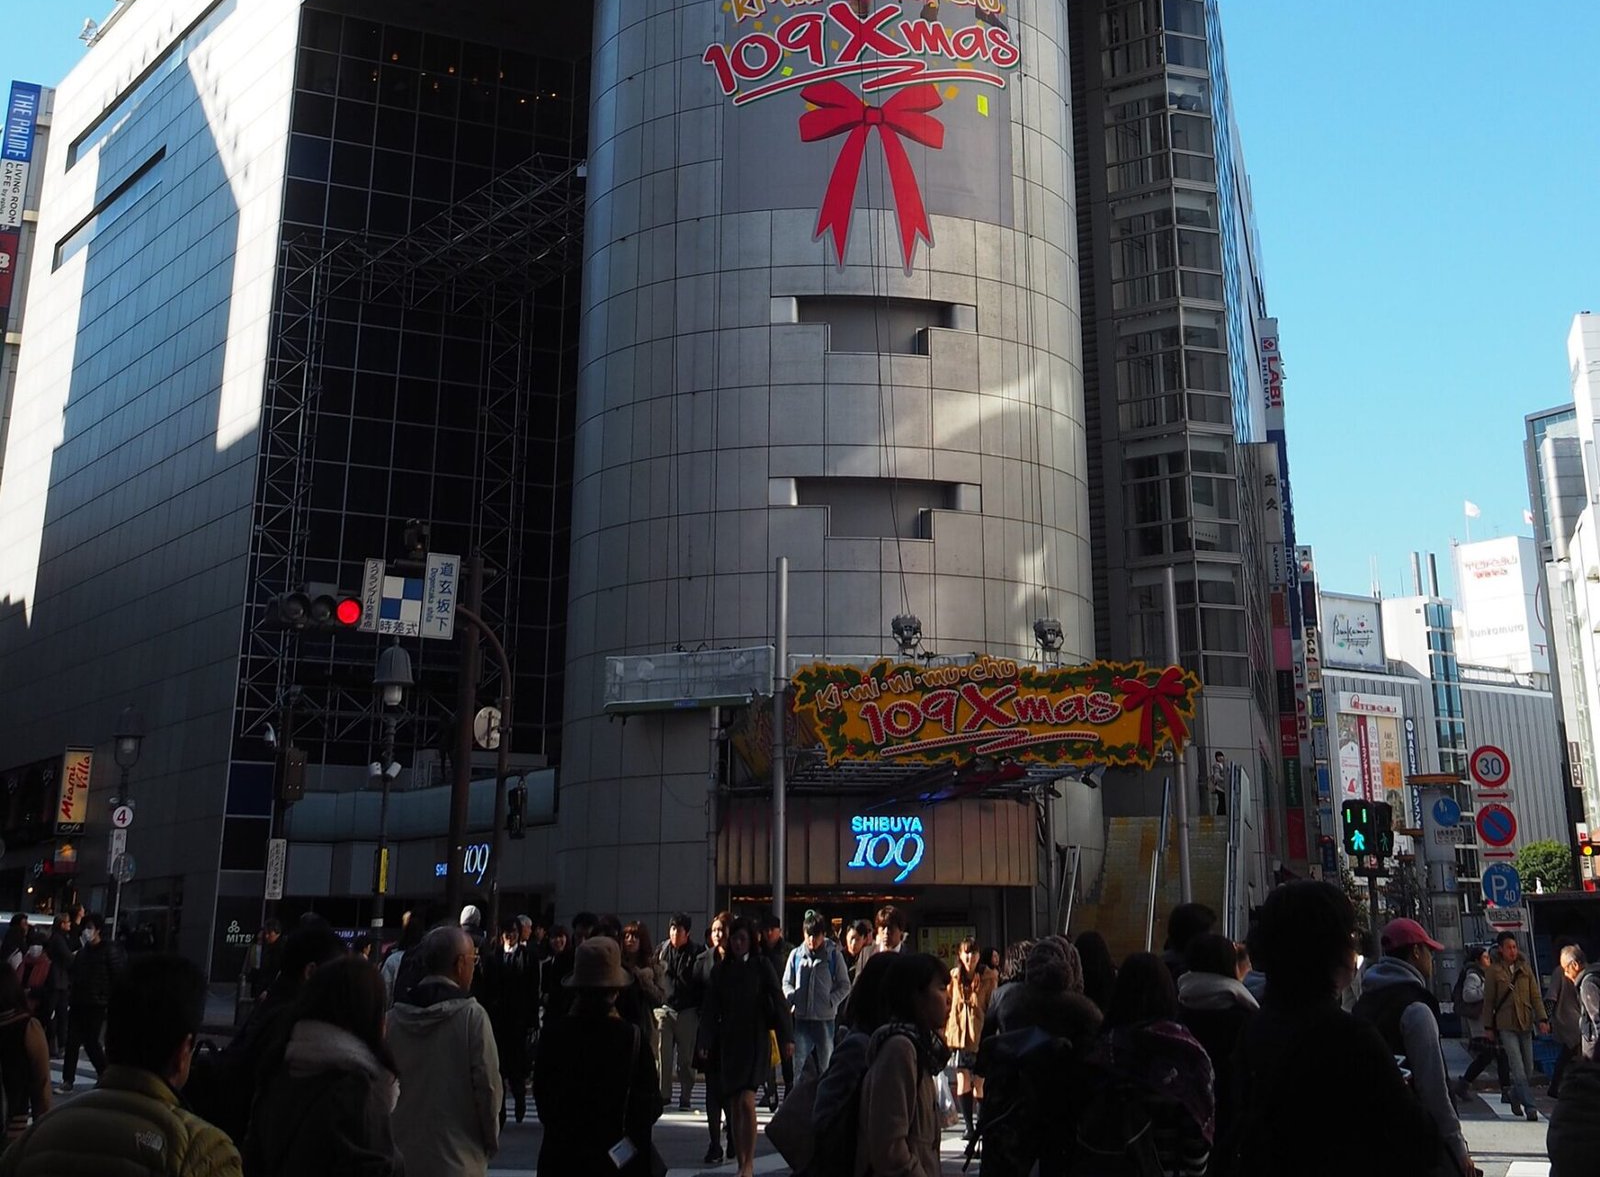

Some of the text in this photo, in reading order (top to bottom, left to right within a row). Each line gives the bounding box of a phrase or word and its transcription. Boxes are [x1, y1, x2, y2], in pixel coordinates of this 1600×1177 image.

[6, 118, 31, 158] PRIME
[3, 161, 14, 188] CAFE
[7, 163, 24, 225] LIVING ROOM
[1261, 356, 1271, 410] SHIBUYA
[1268, 355, 1282, 408] LABI
[436, 562, 455, 632] 道玄坂下
[379, 619, 418, 635] 時差式
[75, 755, 90, 790] Villa
[1479, 756, 1503, 777] 30
[61, 765, 76, 820] Miami
[117, 809, 128, 825] 4
[851, 816, 923, 832] SHIBUYA
[463, 843, 490, 884] 109
[848, 833, 925, 882] 109
[1491, 874, 1508, 903] P
[1504, 890, 1517, 903] 40
